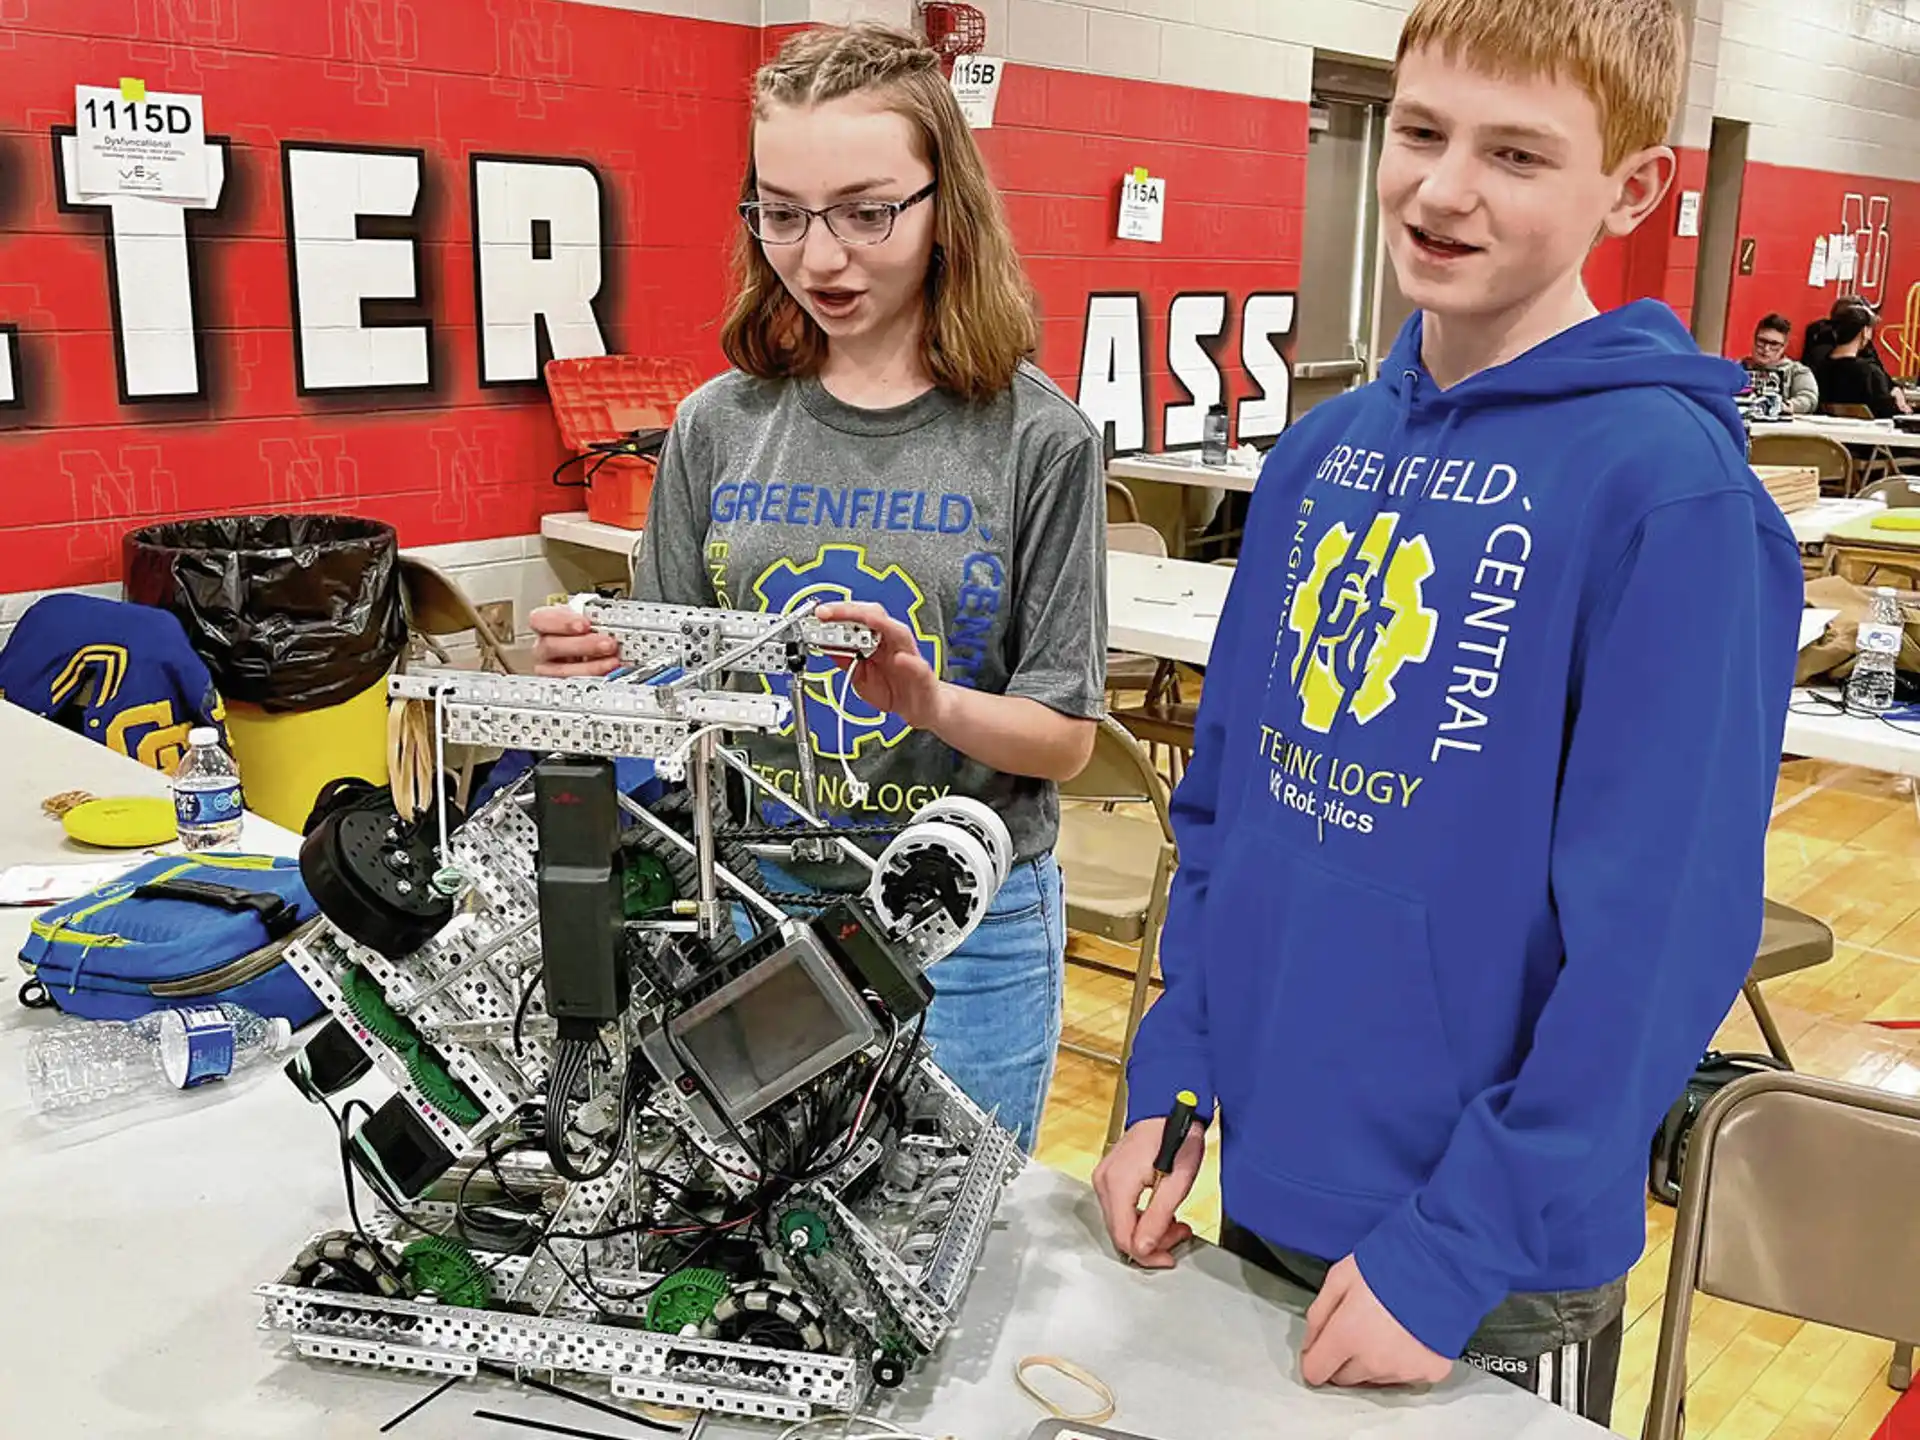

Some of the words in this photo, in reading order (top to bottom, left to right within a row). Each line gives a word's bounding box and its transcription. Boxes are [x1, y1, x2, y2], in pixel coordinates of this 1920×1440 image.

[85, 98, 192, 134] 1115D
[0, 128, 610, 404] TER
[1430, 522, 1533, 763] CENTRAL
[1259, 724, 1424, 809] TENOLOGY
[1283, 782, 1375, 834] Robtics
